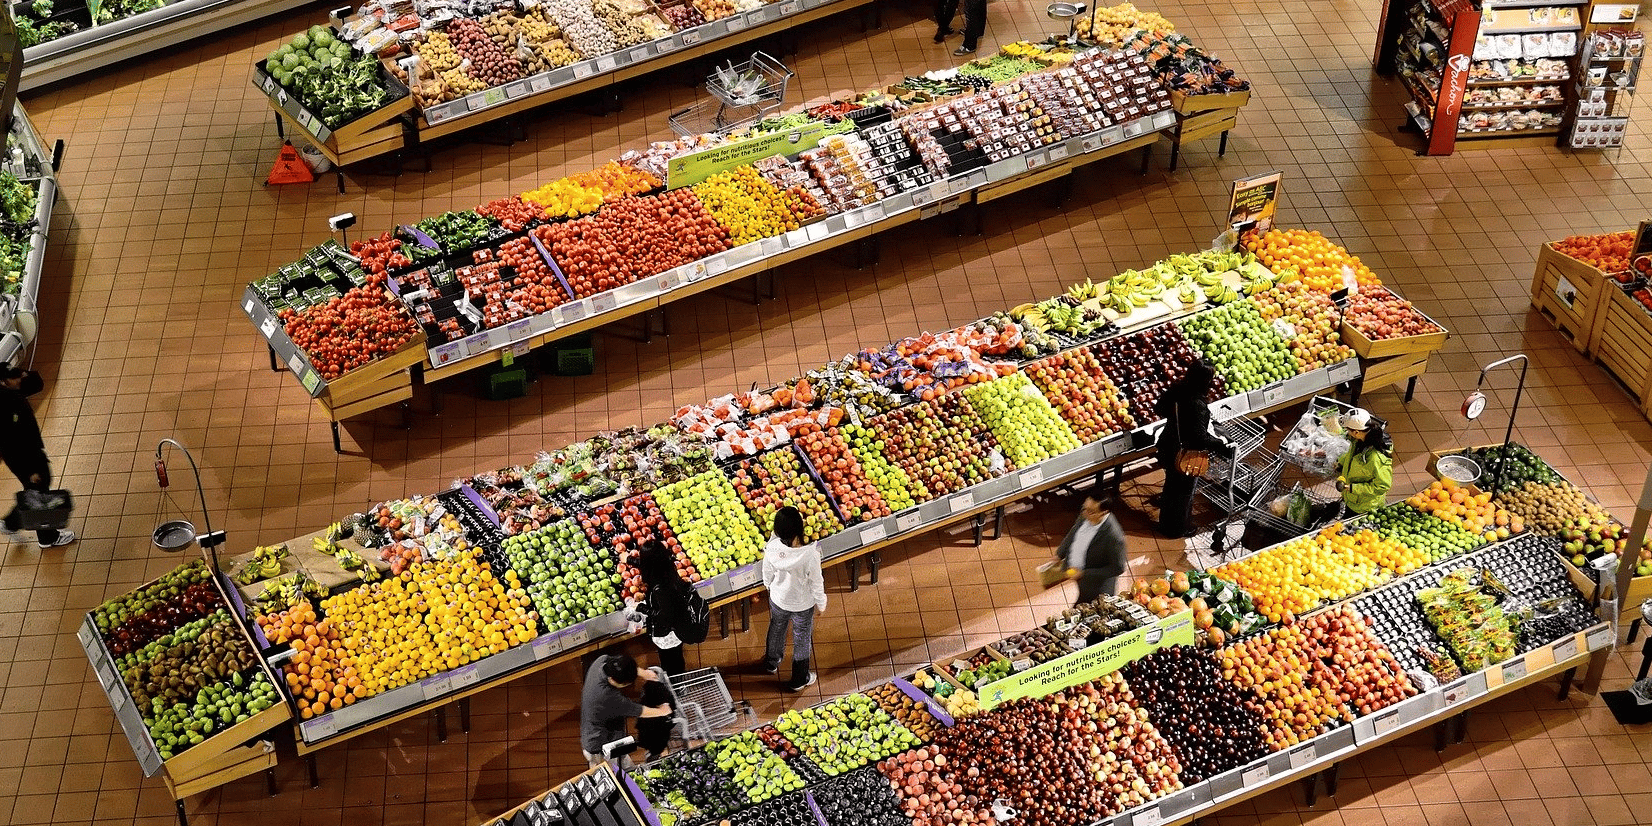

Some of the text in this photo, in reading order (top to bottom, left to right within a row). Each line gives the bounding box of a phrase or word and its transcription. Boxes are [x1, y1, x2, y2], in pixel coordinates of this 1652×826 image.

[1447, 54, 1470, 115] Vachon
[696, 151, 720, 162] Looking
[720, 148, 730, 157] for
[730, 143, 760, 154] nutritious
[760, 134, 786, 146] choices?
[711, 155, 730, 164] Reach
[731, 152, 740, 160] for
[741, 149, 751, 157] the
[752, 144, 770, 154] Stars!
[1018, 669, 1051, 686] Looking
[1052, 663, 1064, 674] for
[1065, 650, 1105, 668] nutritious
[1106, 634, 1141, 652] choices?
[1041, 672, 1066, 686] Reach
[1067, 667, 1080, 678] for
[1081, 661, 1095, 672] the
[1096, 650, 1121, 666] Stars!
